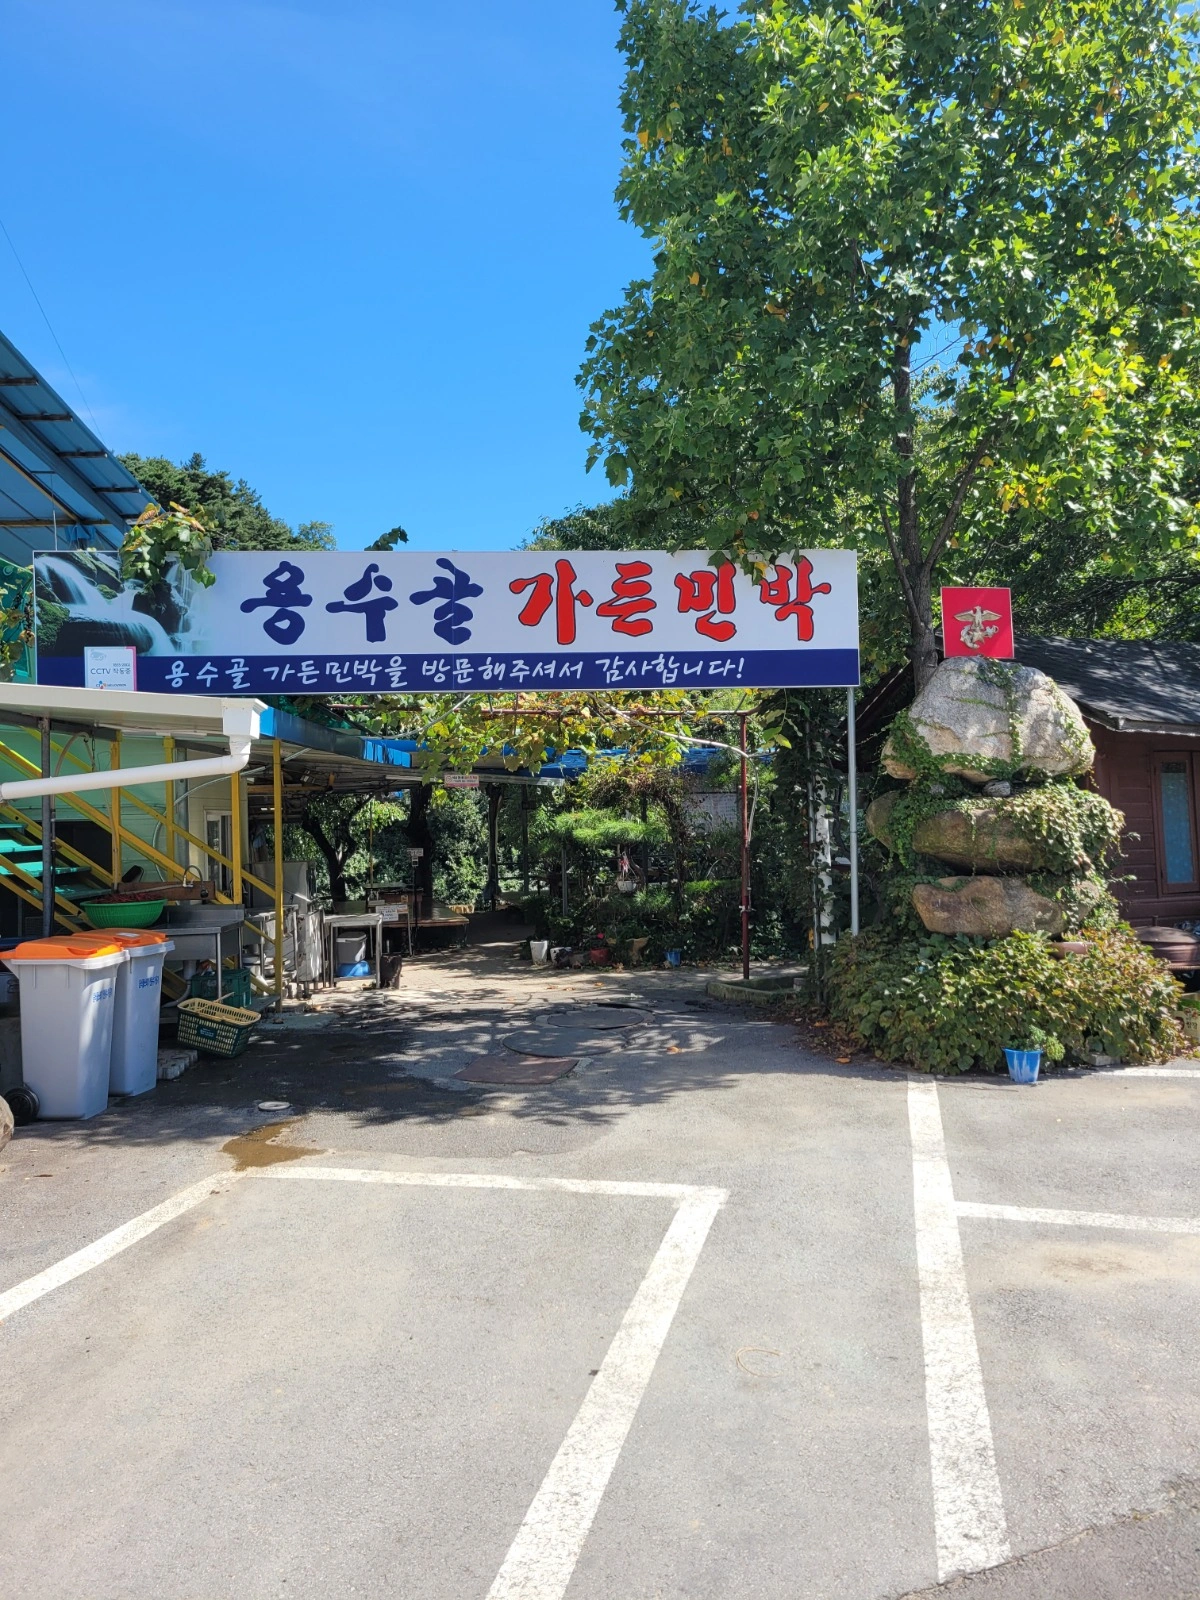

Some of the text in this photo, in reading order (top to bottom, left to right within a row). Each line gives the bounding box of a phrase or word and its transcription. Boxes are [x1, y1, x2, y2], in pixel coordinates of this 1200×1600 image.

[240, 556, 832, 646] 용수골 가든민박
[165, 654, 746, 690] 용수골 가든민박을 방문해주셔서 감사합니다!
